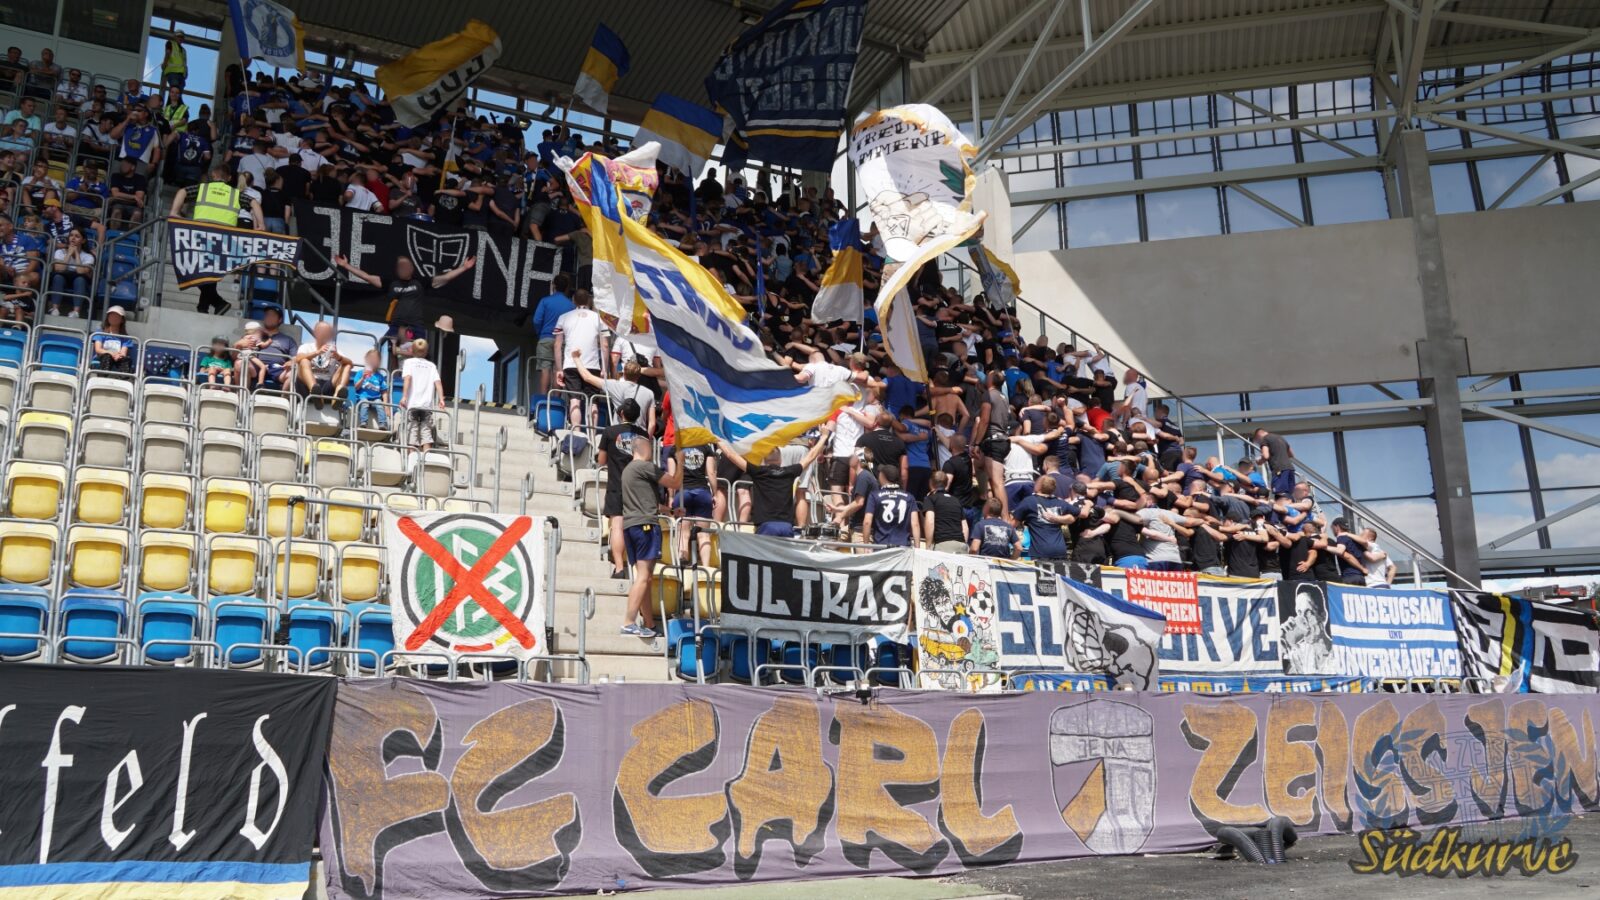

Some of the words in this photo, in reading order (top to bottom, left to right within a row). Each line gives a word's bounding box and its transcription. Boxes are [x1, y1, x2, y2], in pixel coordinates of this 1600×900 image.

[174, 227, 298, 257] REFUGEES
[728, 559, 908, 622] ULTRAS
[1129, 576, 1196, 600] SCHICKERIA
[1341, 592, 1445, 626] UNBEUGSAM
[1388, 630, 1403, 640] UND
[1078, 738, 1128, 758] JENA
[326, 682, 583, 899] FC
[612, 695, 1024, 881] CARL
